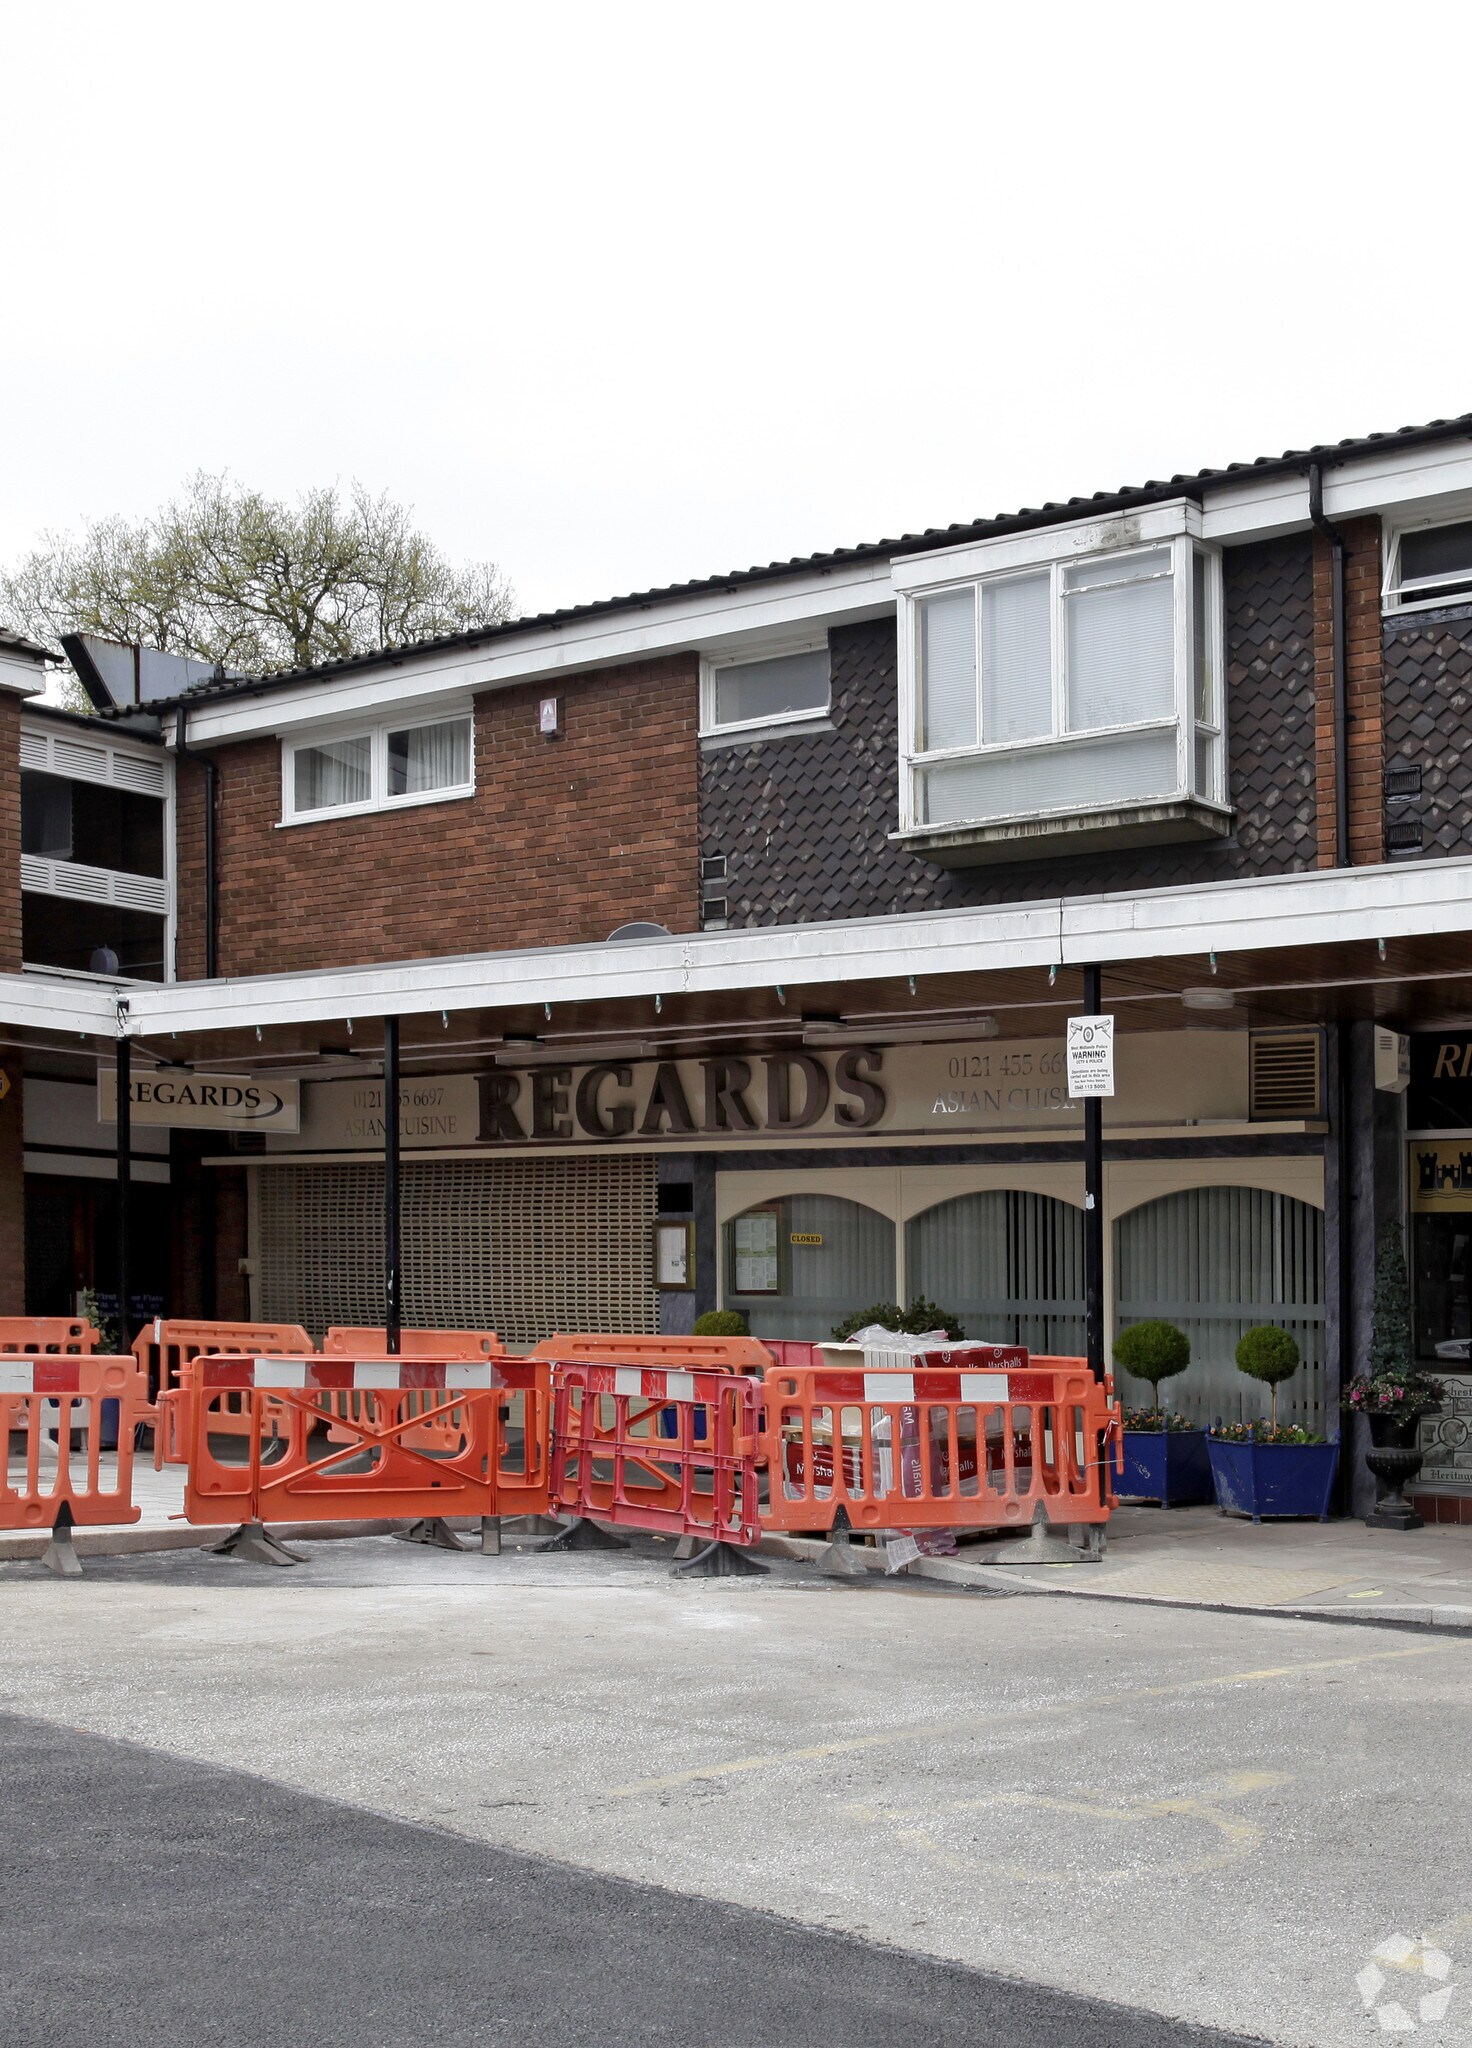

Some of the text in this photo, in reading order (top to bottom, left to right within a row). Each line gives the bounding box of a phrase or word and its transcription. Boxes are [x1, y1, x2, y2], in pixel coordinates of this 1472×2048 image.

[1072, 1050, 1106, 1059] WARNING
[949, 1052, 1068, 1078] 0121 455 66
[354, 1090, 382, 1108] 0121
[413, 1088, 445, 1106] 6697
[474, 1049, 889, 1141] REGARDS
[932, 1087, 1103, 1114] ASIAN CUISI
[344, 1118, 386, 1137] ASIAN
[791, 1235, 821, 1243] CLOSED
[988, 1357, 1021, 1368] Marshalls
